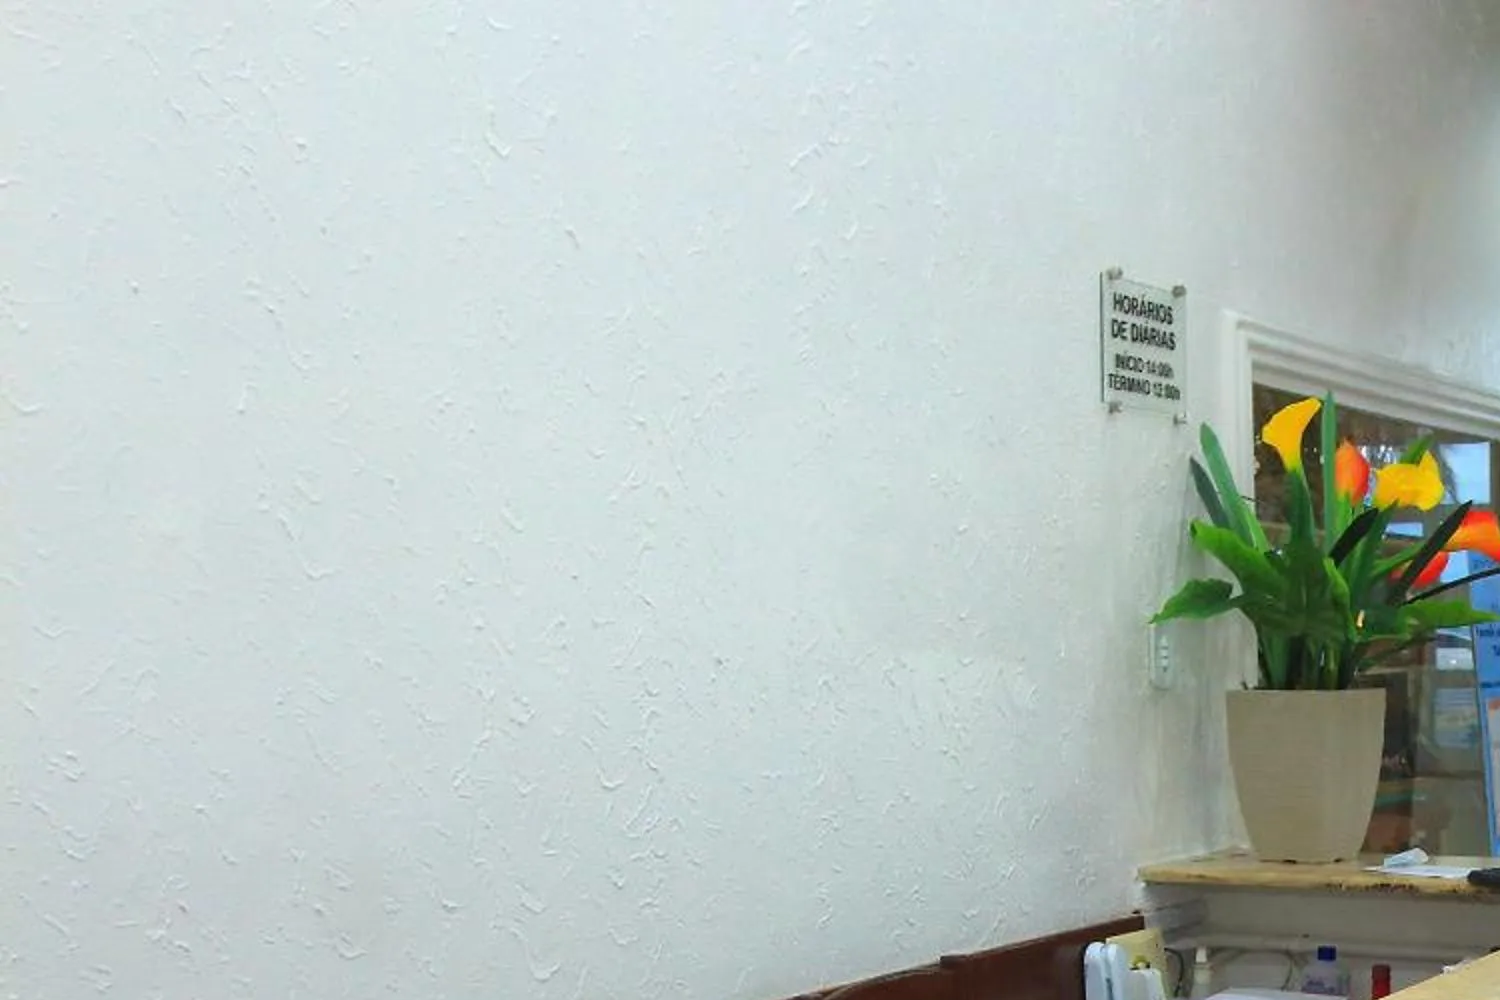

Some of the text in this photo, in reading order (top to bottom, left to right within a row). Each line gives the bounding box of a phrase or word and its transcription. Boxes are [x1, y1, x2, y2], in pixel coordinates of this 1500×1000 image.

[1113, 292, 1174, 325] HORÁRIOS
[1111, 319, 1176, 351] DE DIÁRIAS
